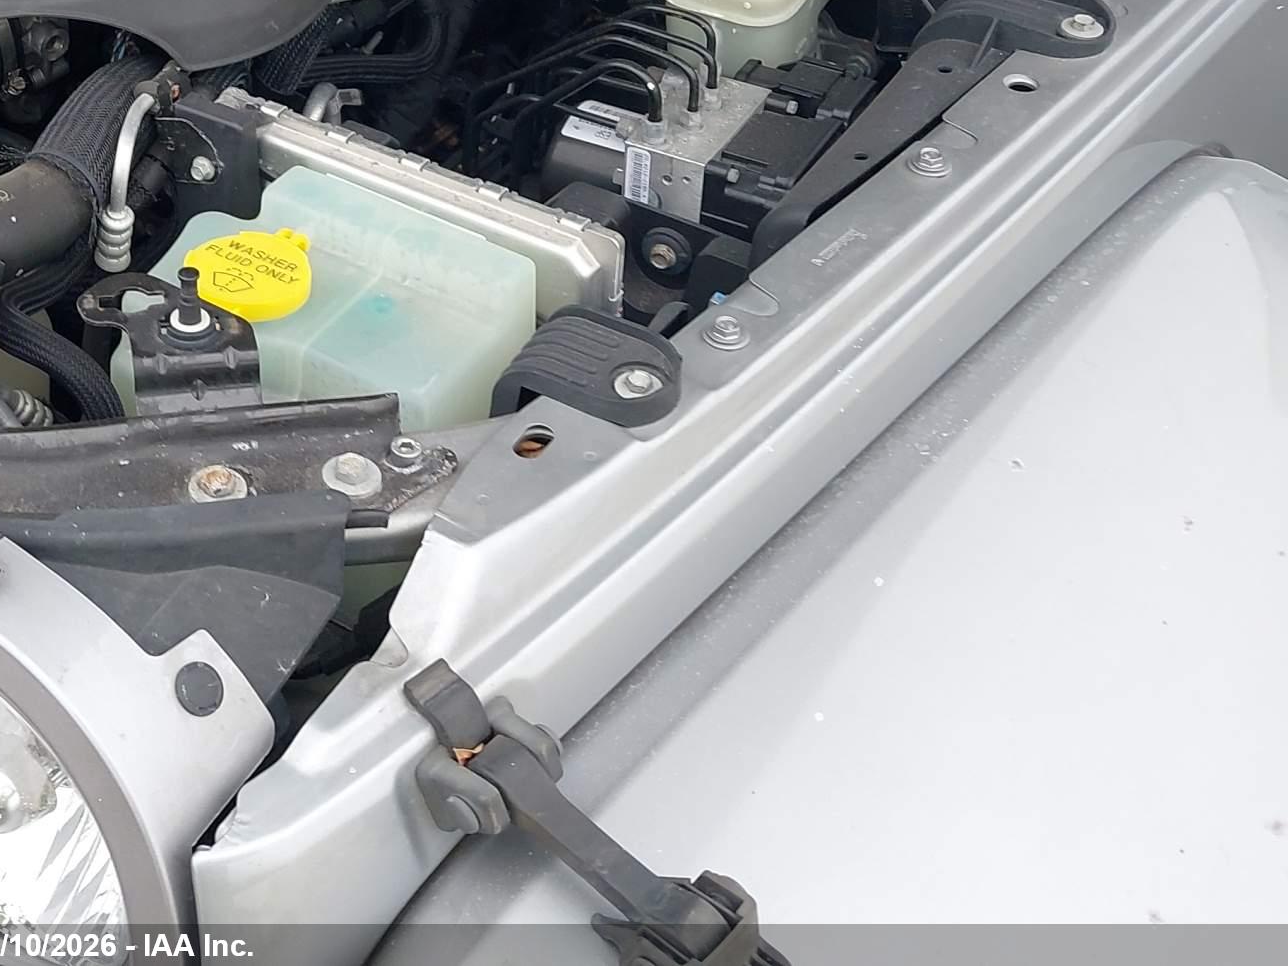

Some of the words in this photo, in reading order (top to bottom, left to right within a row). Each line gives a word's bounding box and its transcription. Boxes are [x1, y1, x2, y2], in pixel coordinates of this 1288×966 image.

[205, 244, 252, 267] FLUID
[255, 264, 300, 284] ONLY
[228, 240, 298, 272] WASHER
